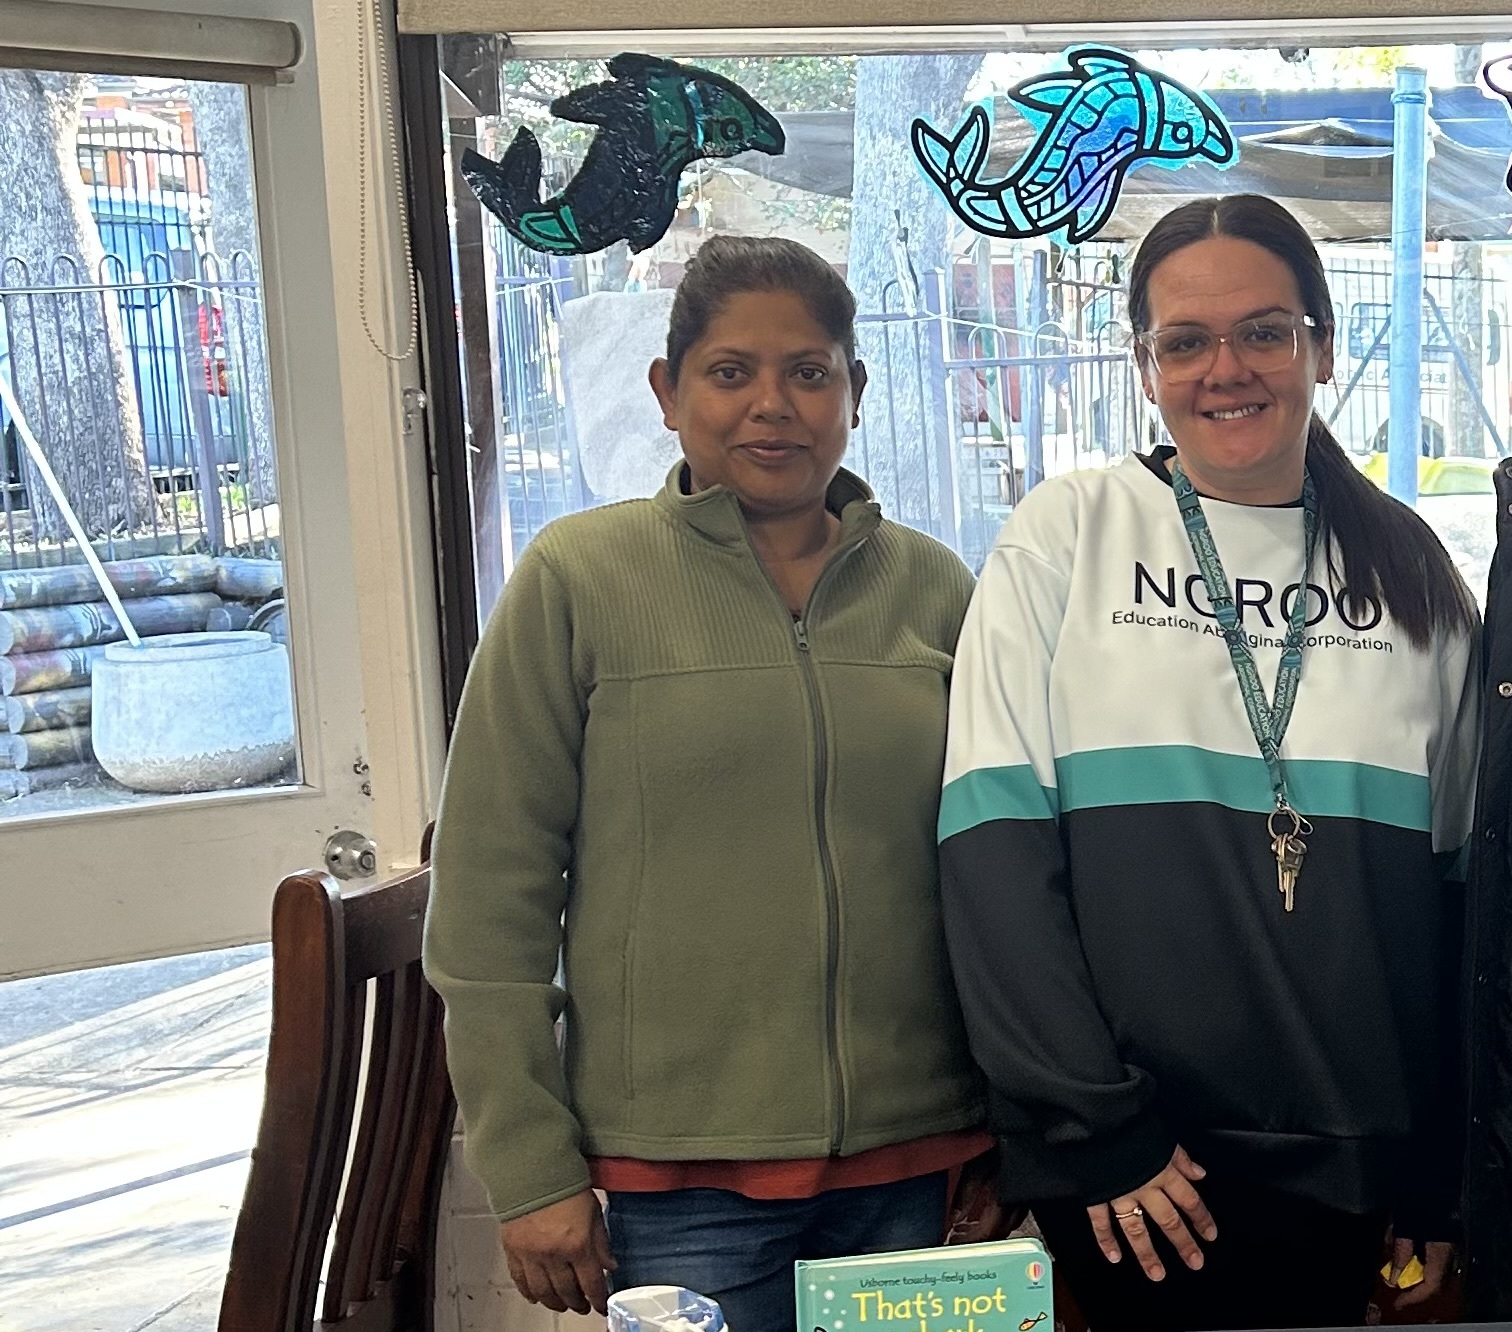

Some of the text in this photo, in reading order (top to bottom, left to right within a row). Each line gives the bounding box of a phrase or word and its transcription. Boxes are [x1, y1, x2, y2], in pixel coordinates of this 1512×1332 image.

[1112, 610, 1199, 633] Education
[1276, 666, 1290, 709] EDUCATION
[1253, 690, 1272, 740] EDUCATION
[860, 1269, 998, 1288] Usborne touchy-feely books
[851, 1287, 1008, 1322] That's not
